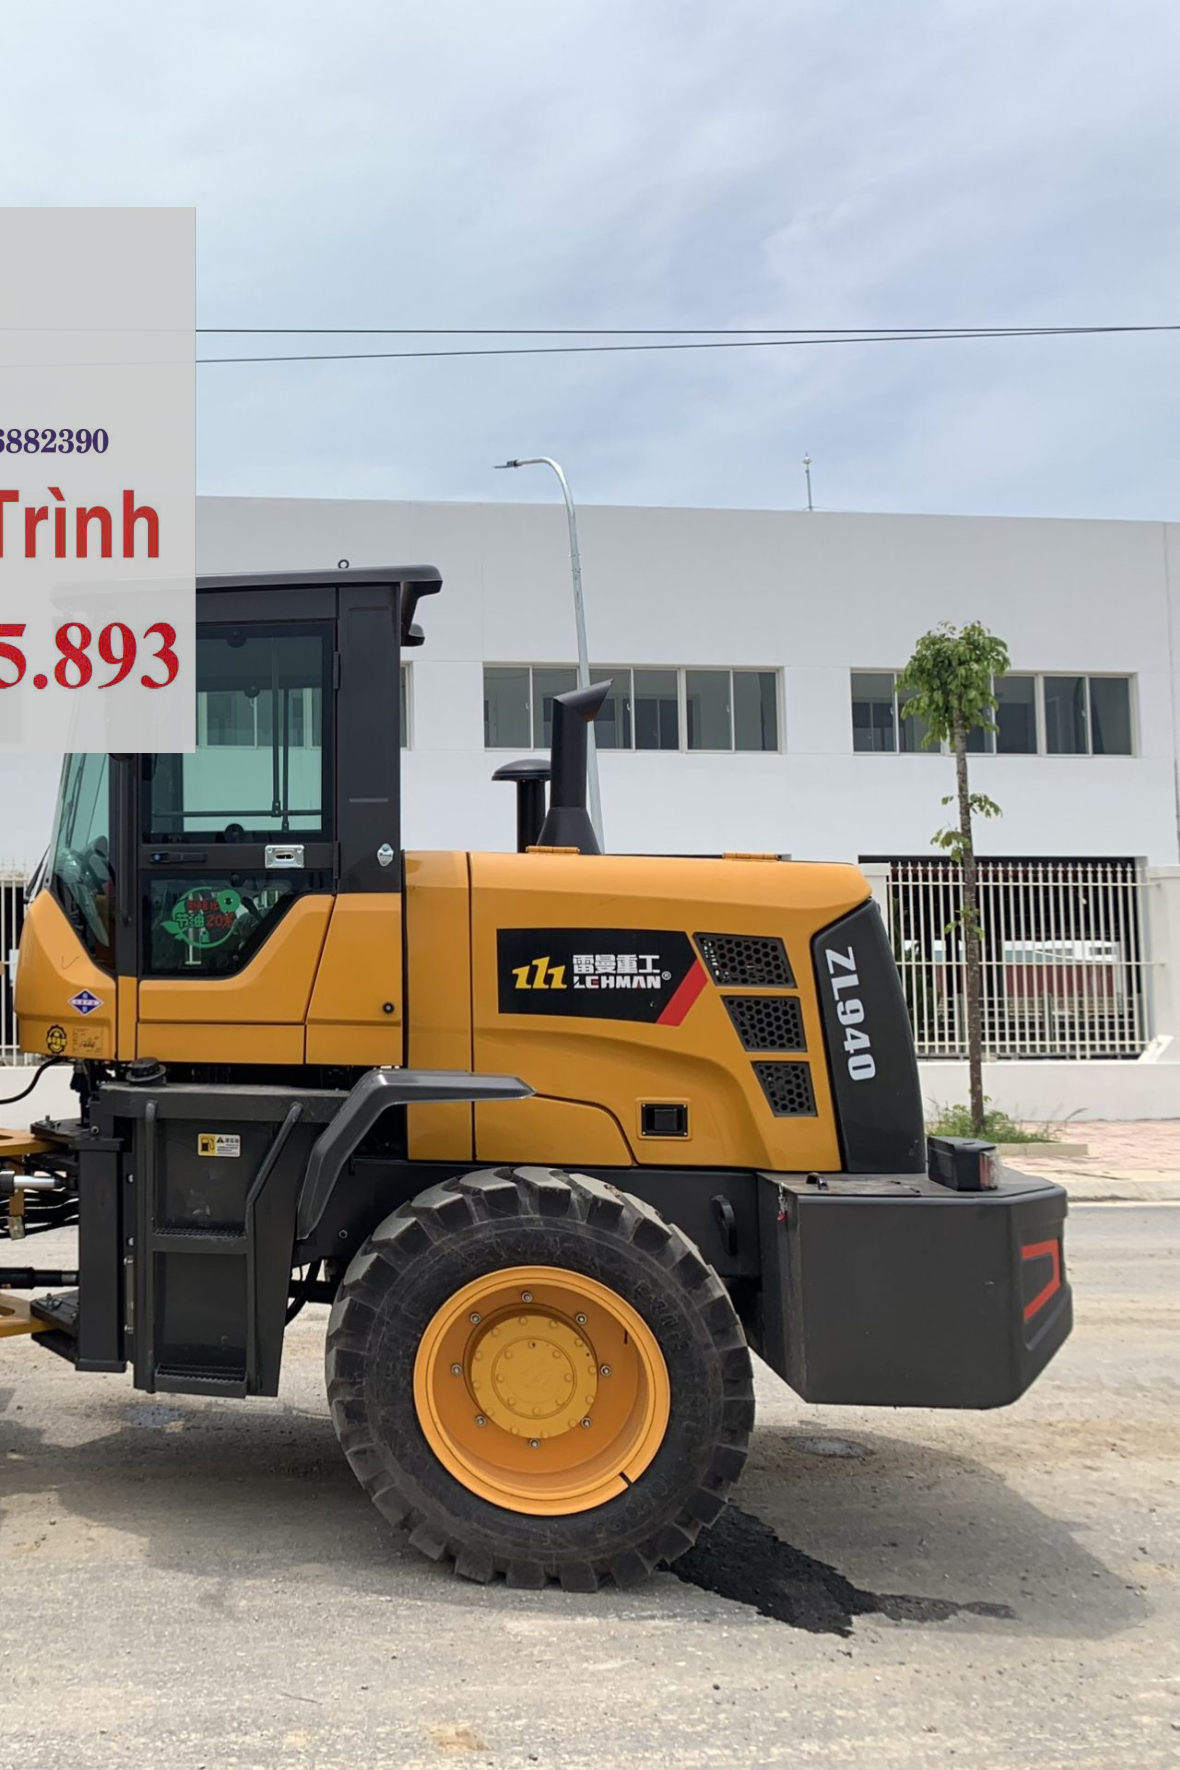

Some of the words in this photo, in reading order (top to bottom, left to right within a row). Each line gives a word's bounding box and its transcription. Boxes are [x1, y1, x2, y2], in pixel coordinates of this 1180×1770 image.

[573, 954, 661, 974] 雷曼重工
[825, 946, 876, 1081] ZL940
